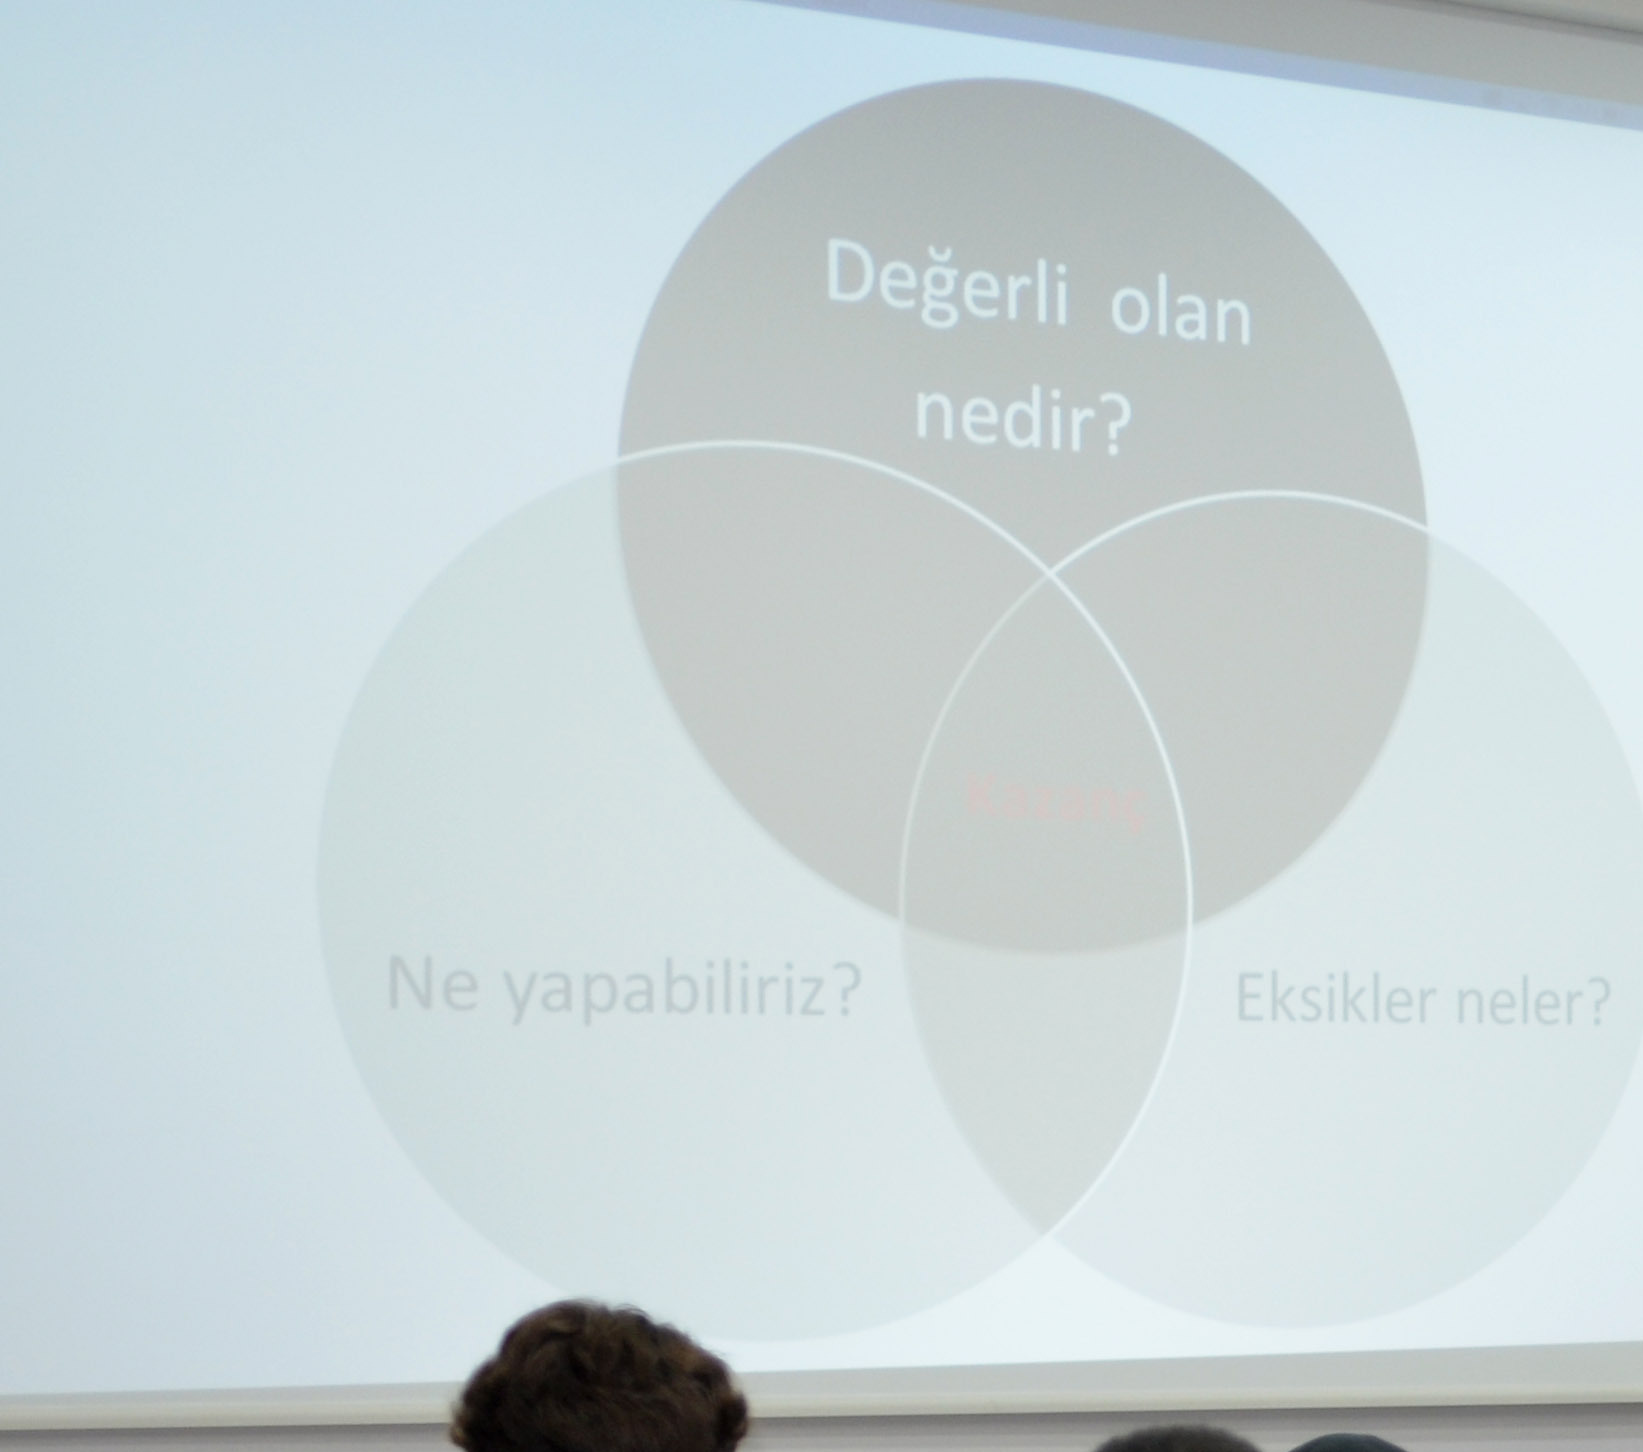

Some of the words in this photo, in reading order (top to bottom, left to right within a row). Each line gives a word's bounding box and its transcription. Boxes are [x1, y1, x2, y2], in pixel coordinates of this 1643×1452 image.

[827, 238, 1069, 329] Değerli
[1111, 272, 1251, 345] olan
[916, 383, 1132, 456] nedir?
[388, 954, 478, 1012] Ne
[503, 957, 862, 1027] yapabiliriz?
[1237, 969, 1437, 1023] Eksikler
[1457, 974, 1611, 1026] neler?
